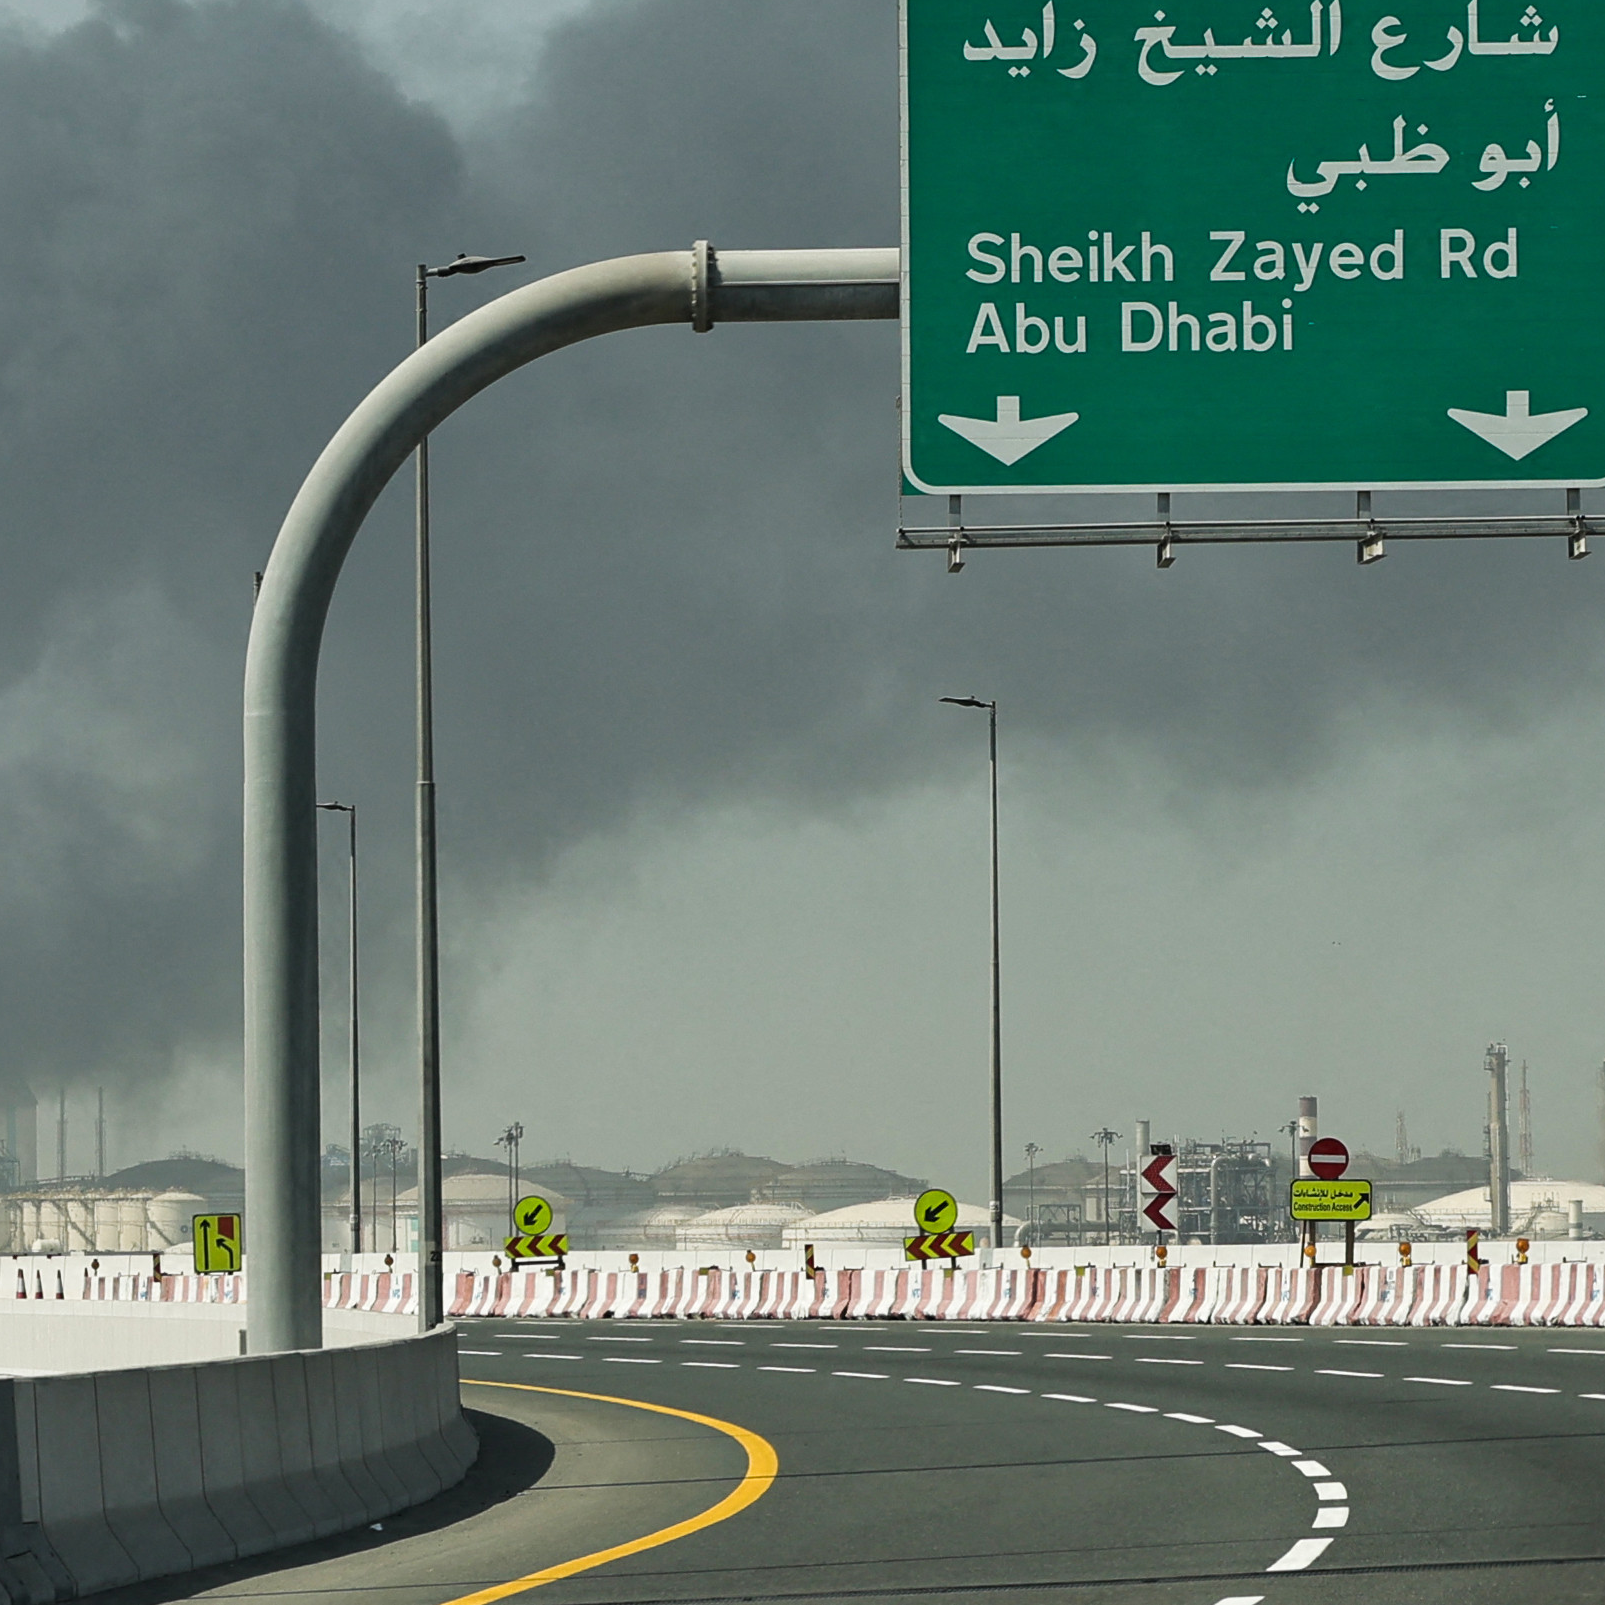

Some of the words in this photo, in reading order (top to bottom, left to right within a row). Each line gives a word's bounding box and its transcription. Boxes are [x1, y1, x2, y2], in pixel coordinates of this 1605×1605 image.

[963, 0, 1097, 79] زايد
[1286, 114, 1450, 215] ظبي
[1471, 98, 1561, 192] أبو
[965, 230, 1174, 284] Sheikh
[1209, 229, 1404, 293] Zayed
[1440, 227, 1517, 279] Rd
[966, 301, 1087, 354] Abu
[1121, 298, 1293, 353] Dhabi
[1293, 1202, 1331, 1212] Construction
[1332, 1202, 1353, 1212] Access
